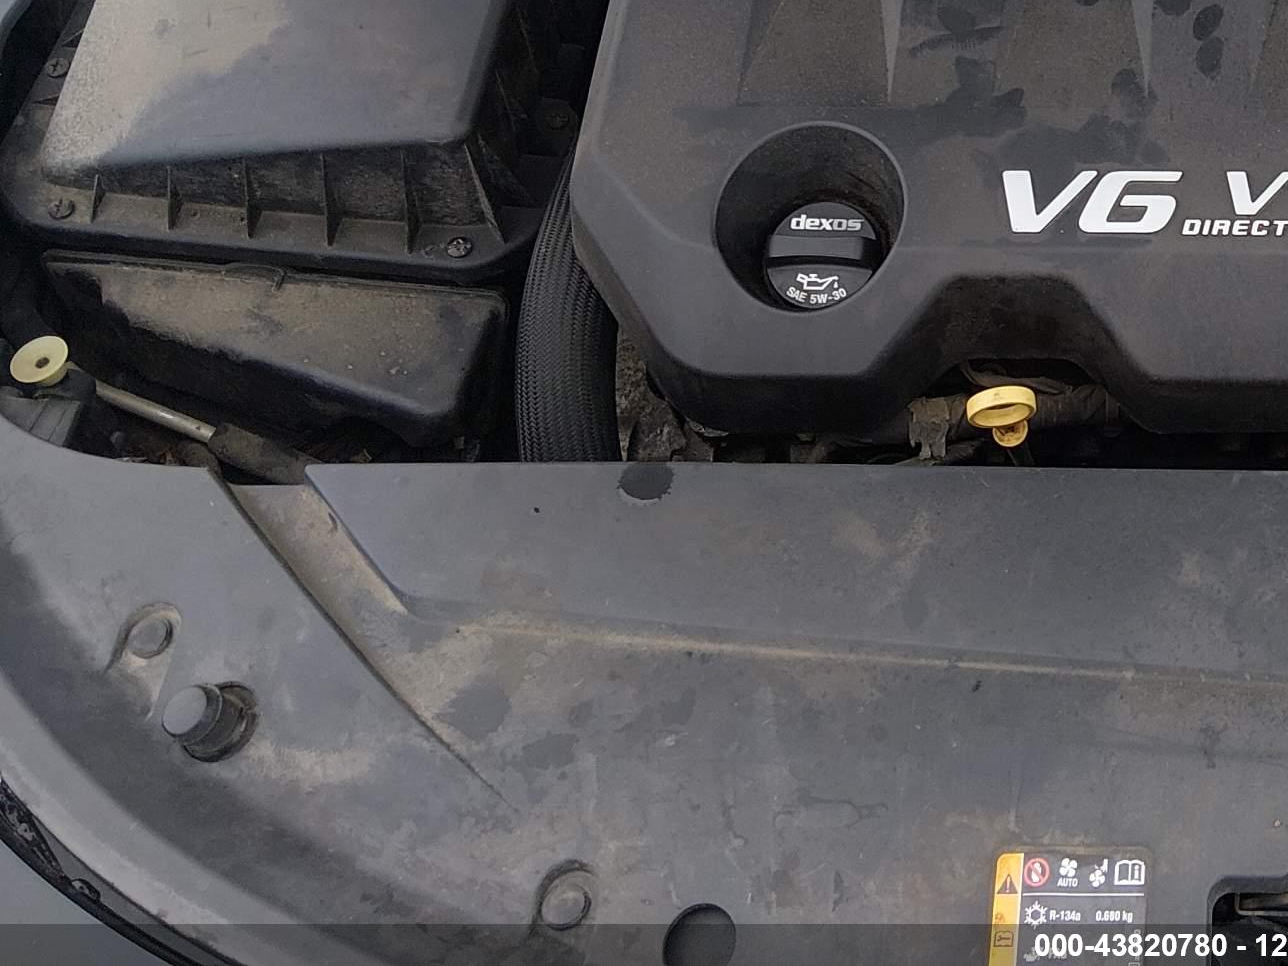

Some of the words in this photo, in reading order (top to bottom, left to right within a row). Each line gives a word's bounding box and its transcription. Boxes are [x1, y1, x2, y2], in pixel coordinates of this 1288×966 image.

[1001, 170, 1184, 235] V6
[789, 214, 865, 231] dexos
[786, 286, 807, 303] SAE
[809, 288, 847, 304] 5W-30
[1057, 877, 1079, 888] AUTO
[1049, 909, 1081, 922] R-134a
[1122, 910, 1133, 923] kg
